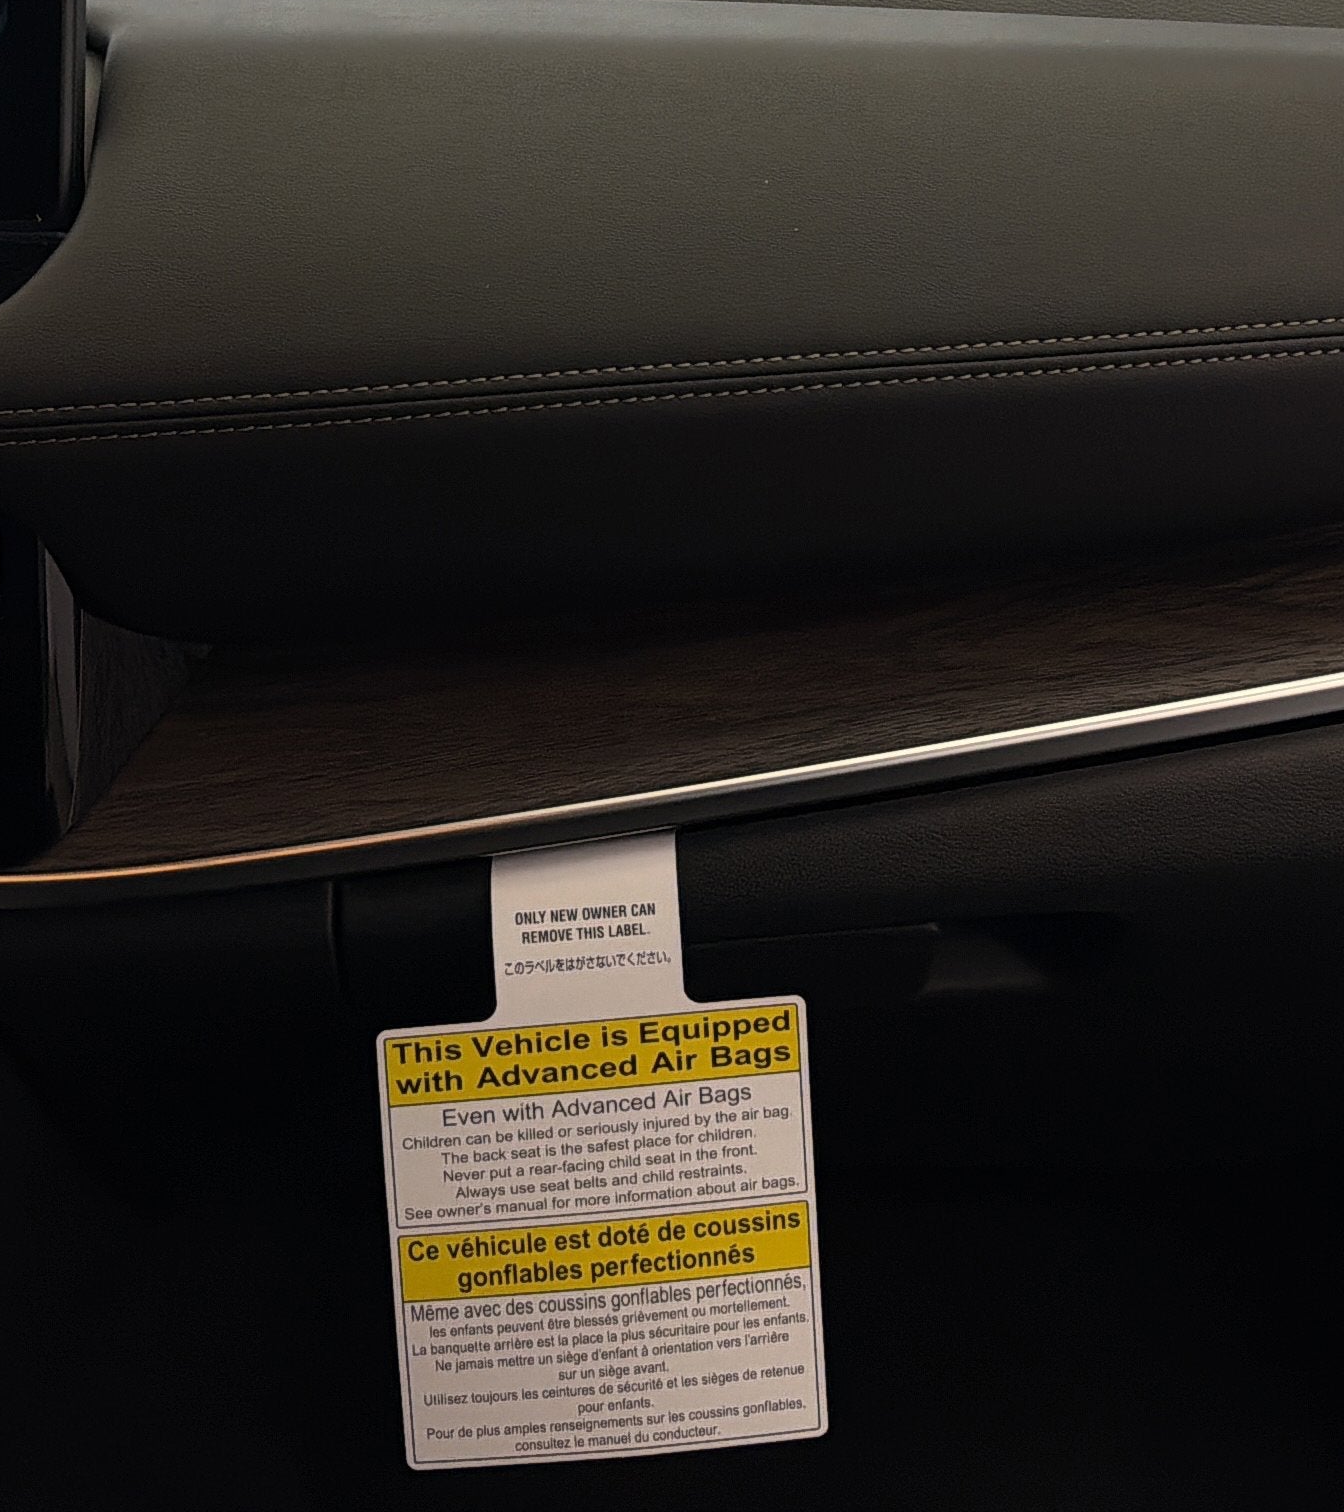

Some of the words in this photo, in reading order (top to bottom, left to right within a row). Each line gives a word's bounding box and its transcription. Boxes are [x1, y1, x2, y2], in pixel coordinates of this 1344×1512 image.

[514, 910, 547, 926] ONLY
[549, 907, 579, 924] NEW
[581, 904, 628, 921] OWNER
[630, 902, 656, 917] CAN
[521, 927, 574, 945] REMOVE
[575, 925, 605, 941] THIS
[608, 922, 651, 938] LABEL.
[391, 1039, 462, 1065] This
[470, 1028, 591, 1058] Vehicle
[601, 1025, 628, 1048] is
[639, 1009, 791, 1047] Equipped
[395, 1069, 463, 1095] with
[476, 1053, 638, 1089] Advanced
[650, 1049, 698, 1074] Air
[710, 1045, 791, 1070] Bags
[401, 1135, 462, 1151] Children
[465, 1133, 492, 1146] can
[495, 1130, 514, 1144] be
[517, 1125, 554, 1143] killed
[557, 1127, 573, 1139] or
[576, 1119, 639, 1137] seriously
[642, 1112, 690, 1134] injured
[693, 1112, 712, 1132] by
[714, 1110, 738, 1131] the
[741, 1106, 760, 1122] air
[762, 1105, 793, 1121] bag.
[442, 1107, 496, 1128] Even
[501, 1101, 545, 1123] with
[551, 1090, 656, 1119] Advanced
[662, 1087, 693, 1109] Air
[698, 1086, 752, 1107] Bags
[440, 1151, 469, 1169] The
[472, 1147, 510, 1163] back
[510, 1144, 542, 1160] seat
[544, 1143, 557, 1158] is
[560, 1142, 583, 1156] the
[586, 1137, 630, 1154] safest
[631, 1131, 672, 1153] place
[674, 1129, 695, 1146] for
[697, 1127, 757, 1149] children.
[407, 1240, 441, 1262] Ce
[447, 1231, 548, 1260] véhicule
[554, 1227, 591, 1250] est
[596, 1221, 651, 1248] doté
[657, 1219, 687, 1242] de
[692, 1210, 803, 1239] coussins
[457, 1259, 583, 1294] gonflables
[590, 1242, 755, 1284] perfectionnés
[410, 1303, 460, 1323] Même
[463, 1303, 502, 1320] avec
[505, 1297, 534, 1316] des
[538, 1288, 607, 1314] coussins
[610, 1284, 692, 1311] gonflables
[695, 1272, 807, 1304] perfectionnés,
[514, 1432, 574, 1452] consultez
[573, 1434, 585, 1449] le
[586, 1428, 632, 1448] manuel
[633, 1429, 650, 1444] du
[652, 1425, 722, 1442] conducteur.
